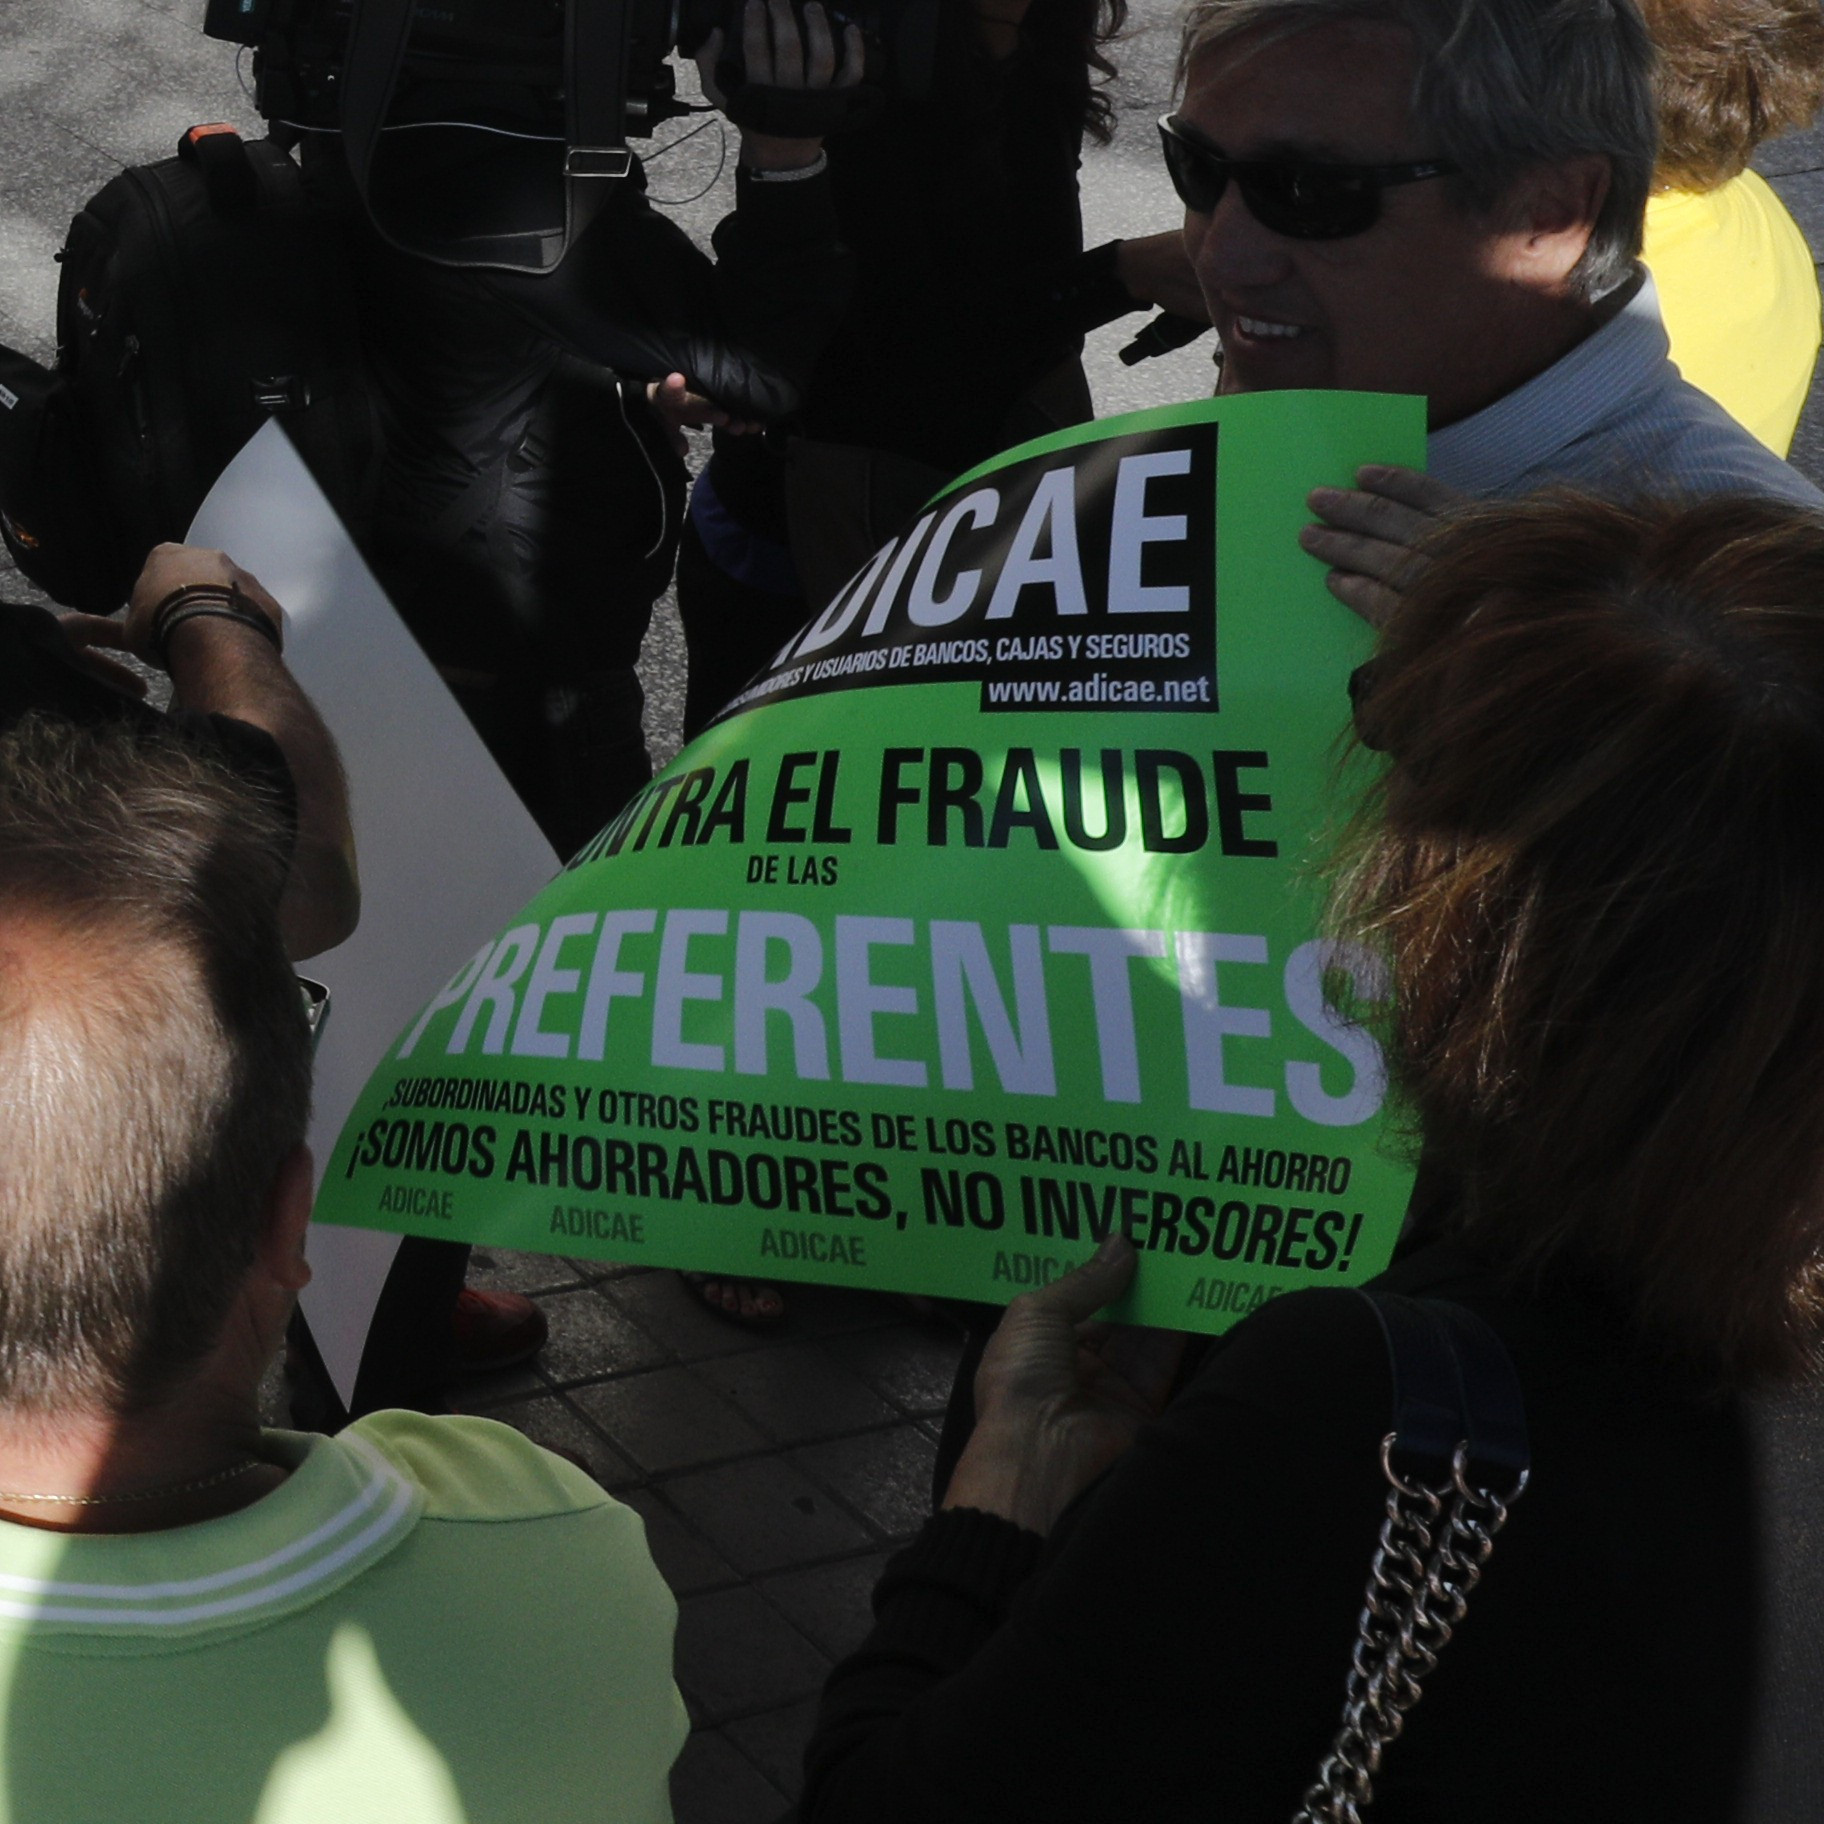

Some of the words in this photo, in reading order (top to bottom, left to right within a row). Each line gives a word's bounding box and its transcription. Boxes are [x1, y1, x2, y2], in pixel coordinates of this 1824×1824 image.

[769, 449, 1192, 670] DICAE
[802, 664, 815, 685] Y
[812, 650, 888, 681] USUARIOS
[889, 644, 913, 669] DE
[913, 640, 993, 668] BANCOS,
[995, 636, 1063, 662] CAJAS
[1068, 635, 1084, 660] Y
[1085, 633, 1190, 659] SEGUROS
[988, 673, 1210, 703] www.adicae.net
[766, 750, 852, 845] EL
[877, 747, 1279, 859] FRAUDE
[746, 854, 778, 885] DE
[786, 855, 839, 887] LAS
[395, 906, 1389, 1127] PREFERENTES
[345, 1118, 496, 1179] ¡SOMOS
[504, 1128, 909, 1231] AHORRADORES,
[920, 1167, 1006, 1231] NO
[1020, 1175, 1364, 1273] INVERSORES!
[574, 1085, 594, 1121] Y
[598, 1089, 699, 1133] OTROS
[708, 1099, 862, 1150] FRAUDES
[871, 1112, 919, 1153] DE
[925, 1116, 997, 1159] LOS
[1005, 1122, 1159, 1175] BANCOS
[1168, 1139, 1208, 1181] AL
[1216, 1144, 1353, 1196] AHORRO
[378, 1184, 453, 1219] ADICAE
[550, 1205, 645, 1244] ADICAE
[760, 1227, 868, 1267] ADICAE
